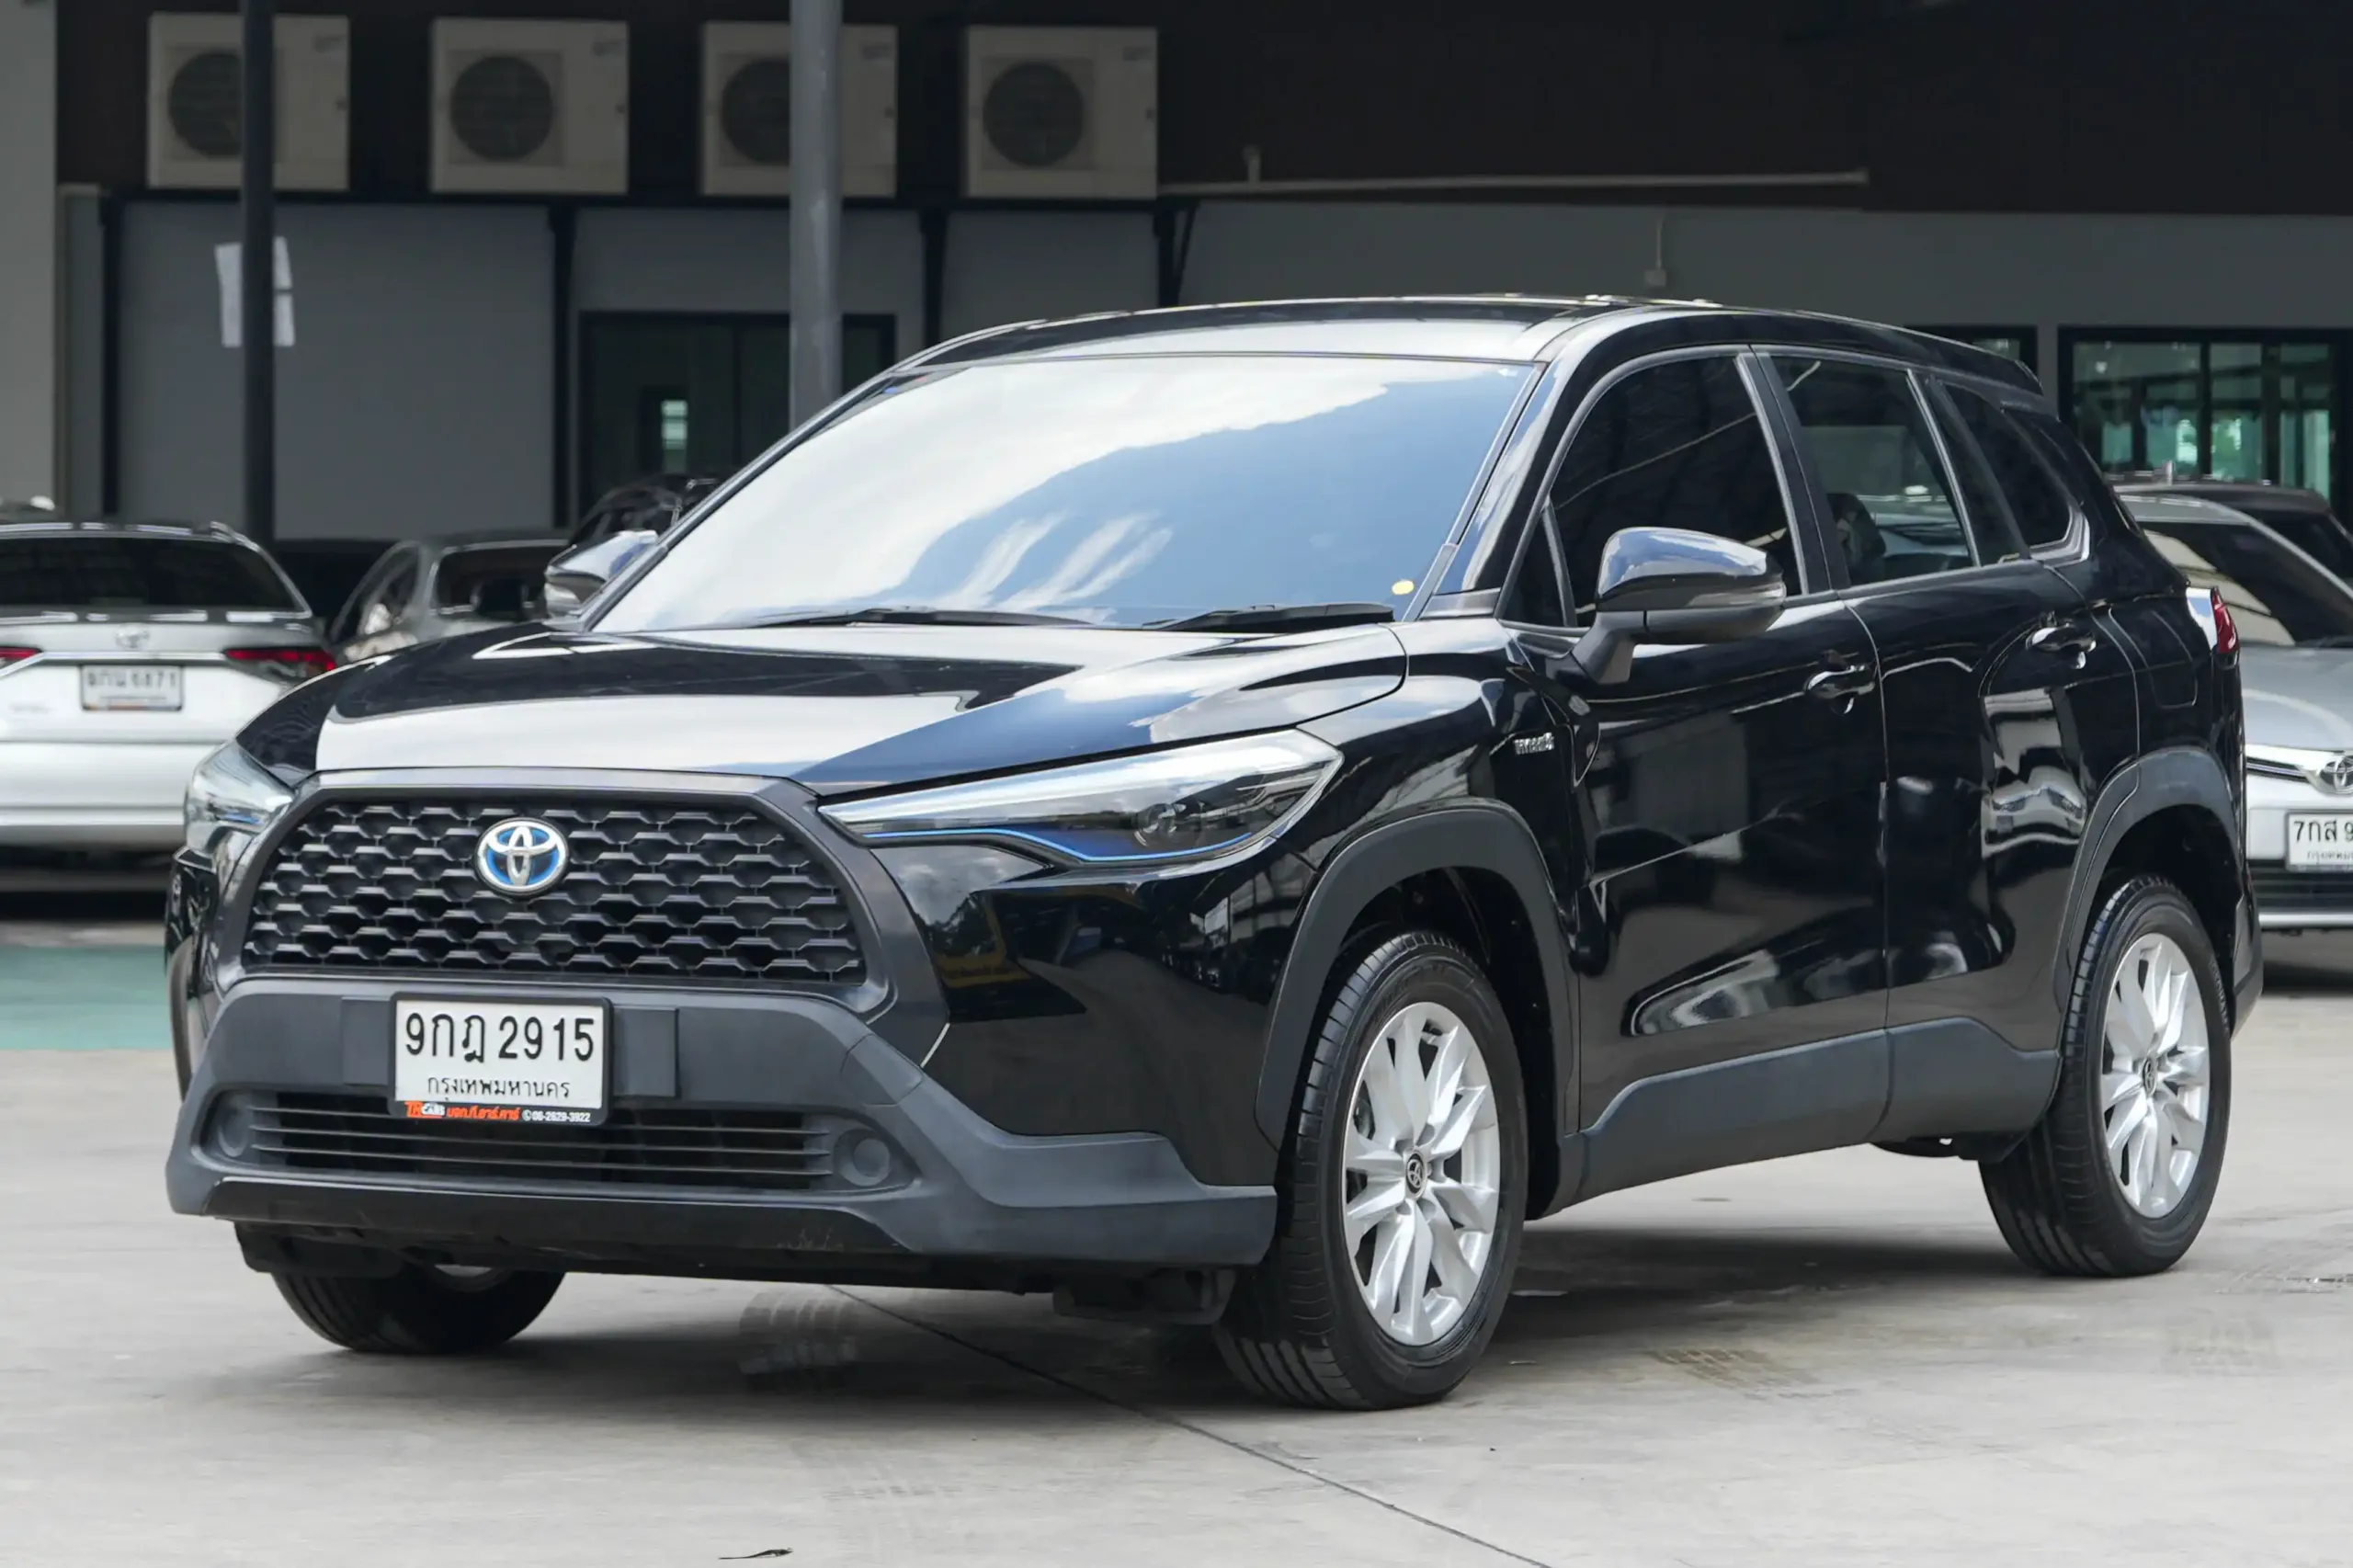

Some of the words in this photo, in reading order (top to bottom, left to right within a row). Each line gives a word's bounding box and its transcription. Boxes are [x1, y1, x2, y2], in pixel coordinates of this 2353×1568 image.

[2294, 819, 2337, 843] 7กส
[405, 1012, 485, 1063] 9กฎ
[498, 1016, 595, 1062] 2915
[427, 1076, 571, 1101] กรุงเทพมหานคร
